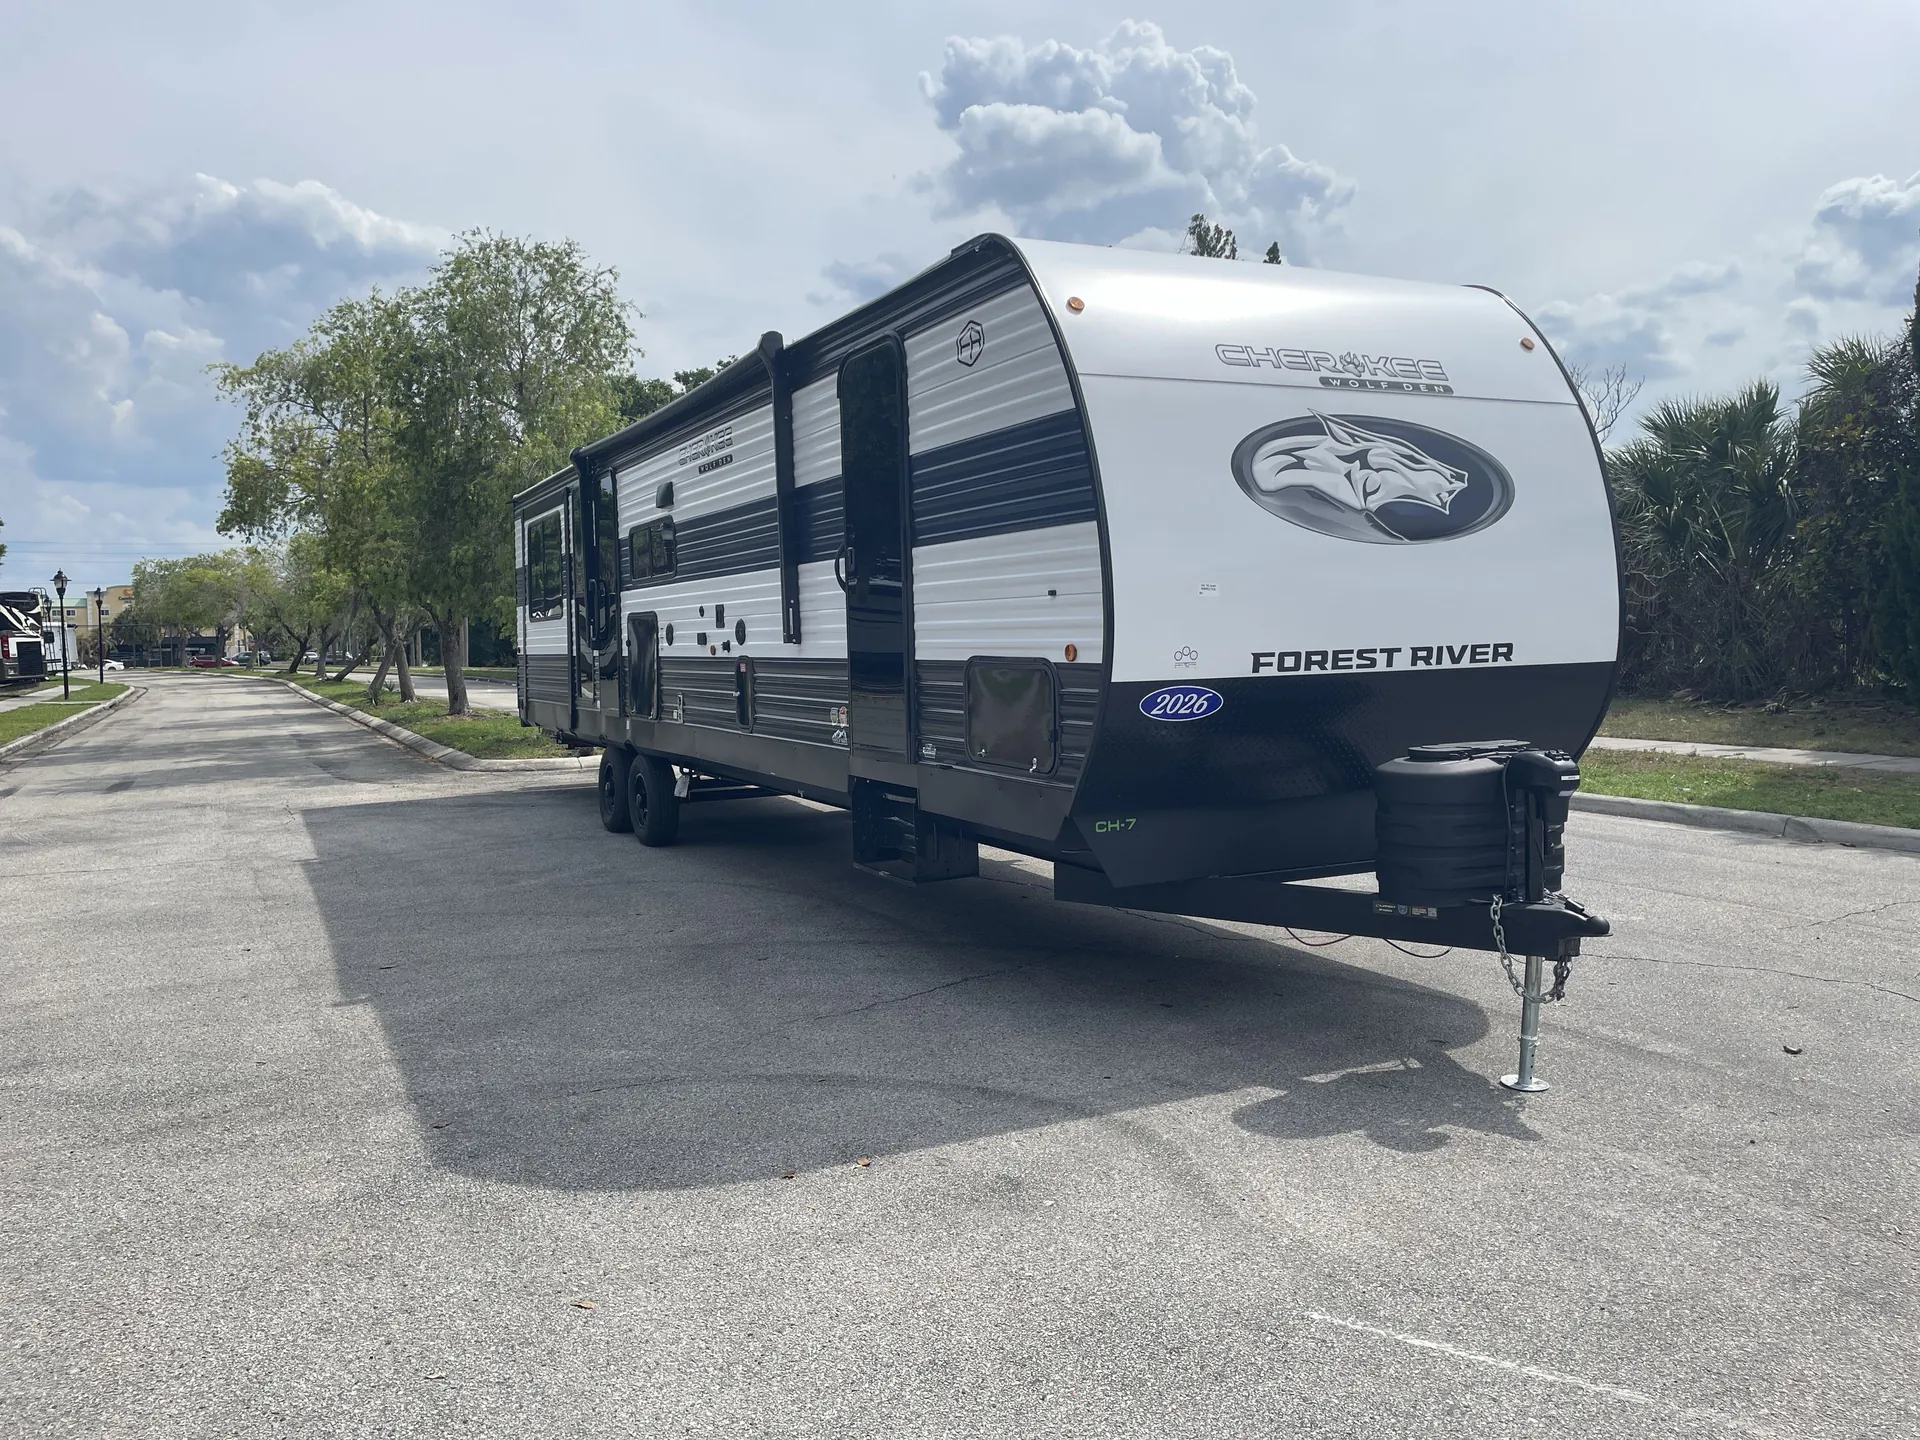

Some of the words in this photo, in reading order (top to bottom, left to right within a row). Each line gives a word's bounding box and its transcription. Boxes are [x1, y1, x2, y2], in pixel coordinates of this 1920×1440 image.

[1329, 378, 1388, 390] WOLF
[1403, 383, 1445, 393] DEN
[699, 461, 716, 472] WOLF
[718, 455, 731, 466] DEN
[1251, 647, 1402, 674] FOREST
[1410, 642, 1514, 667] RIVER
[1150, 693, 1213, 715] 2026
[1095, 818, 1137, 833] CH-7
